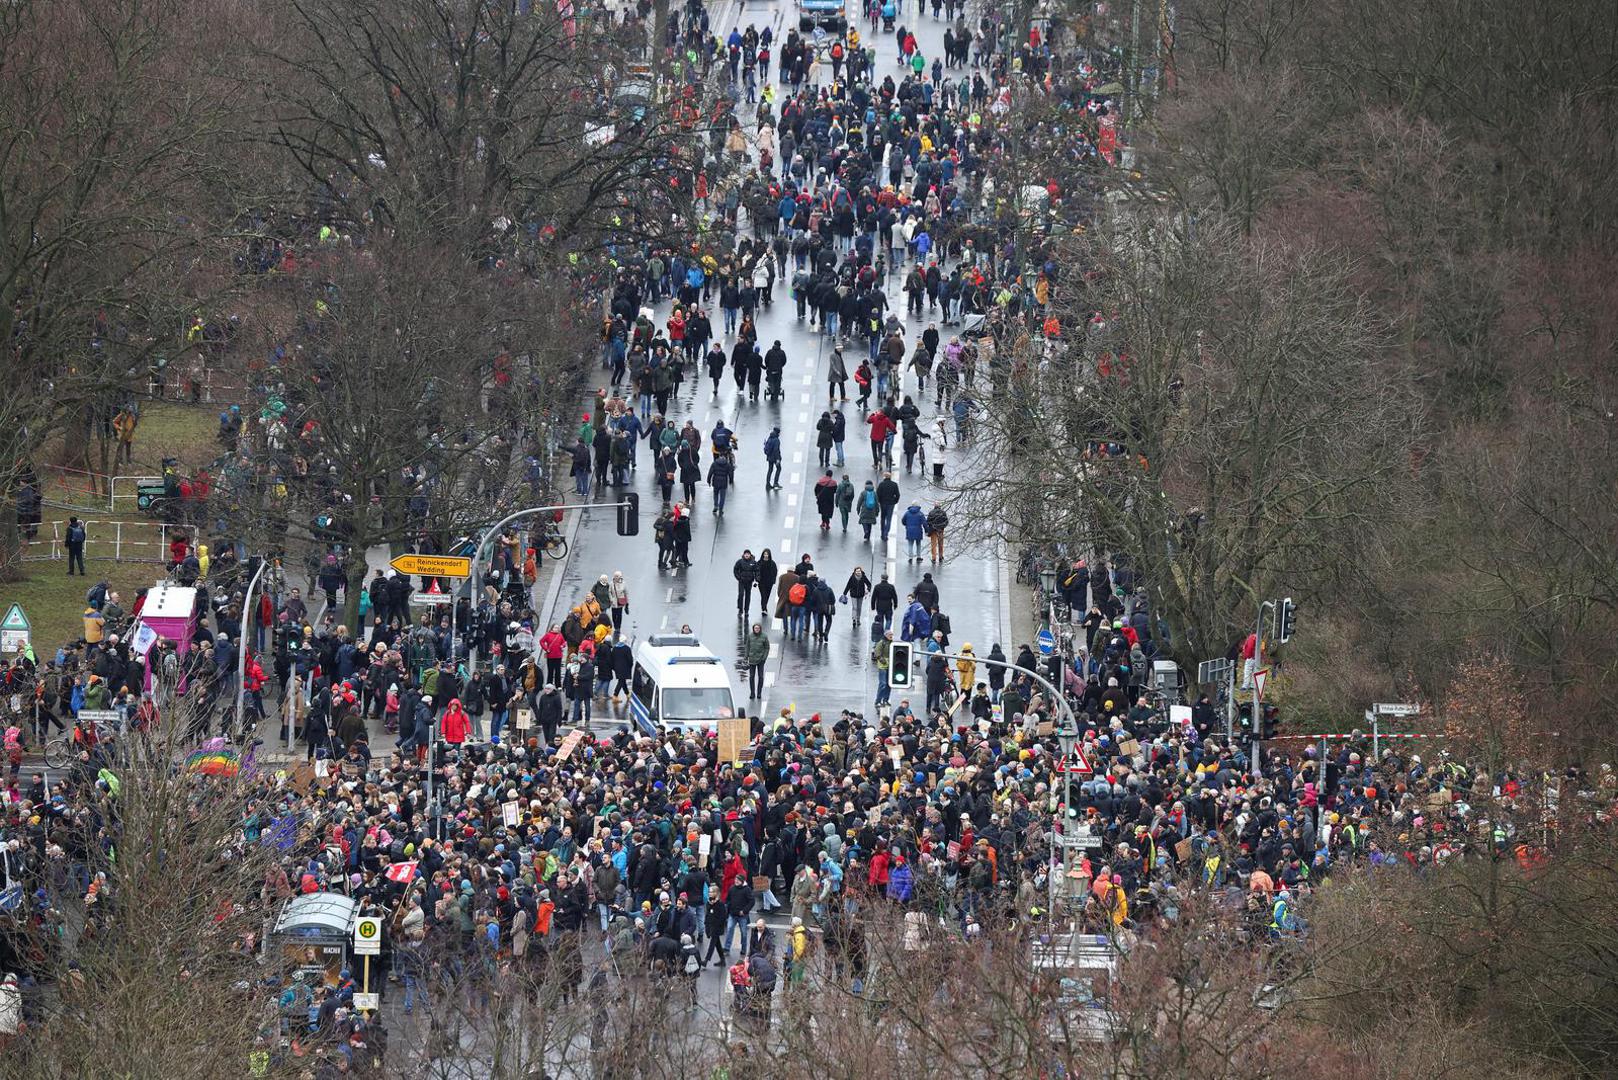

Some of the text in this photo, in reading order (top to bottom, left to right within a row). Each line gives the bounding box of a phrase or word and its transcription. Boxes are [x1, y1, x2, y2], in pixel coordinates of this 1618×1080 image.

[417, 559, 463, 567] Reinickendorf
[417, 566, 445, 574] Wedding
[364, 924, 372, 934] H
